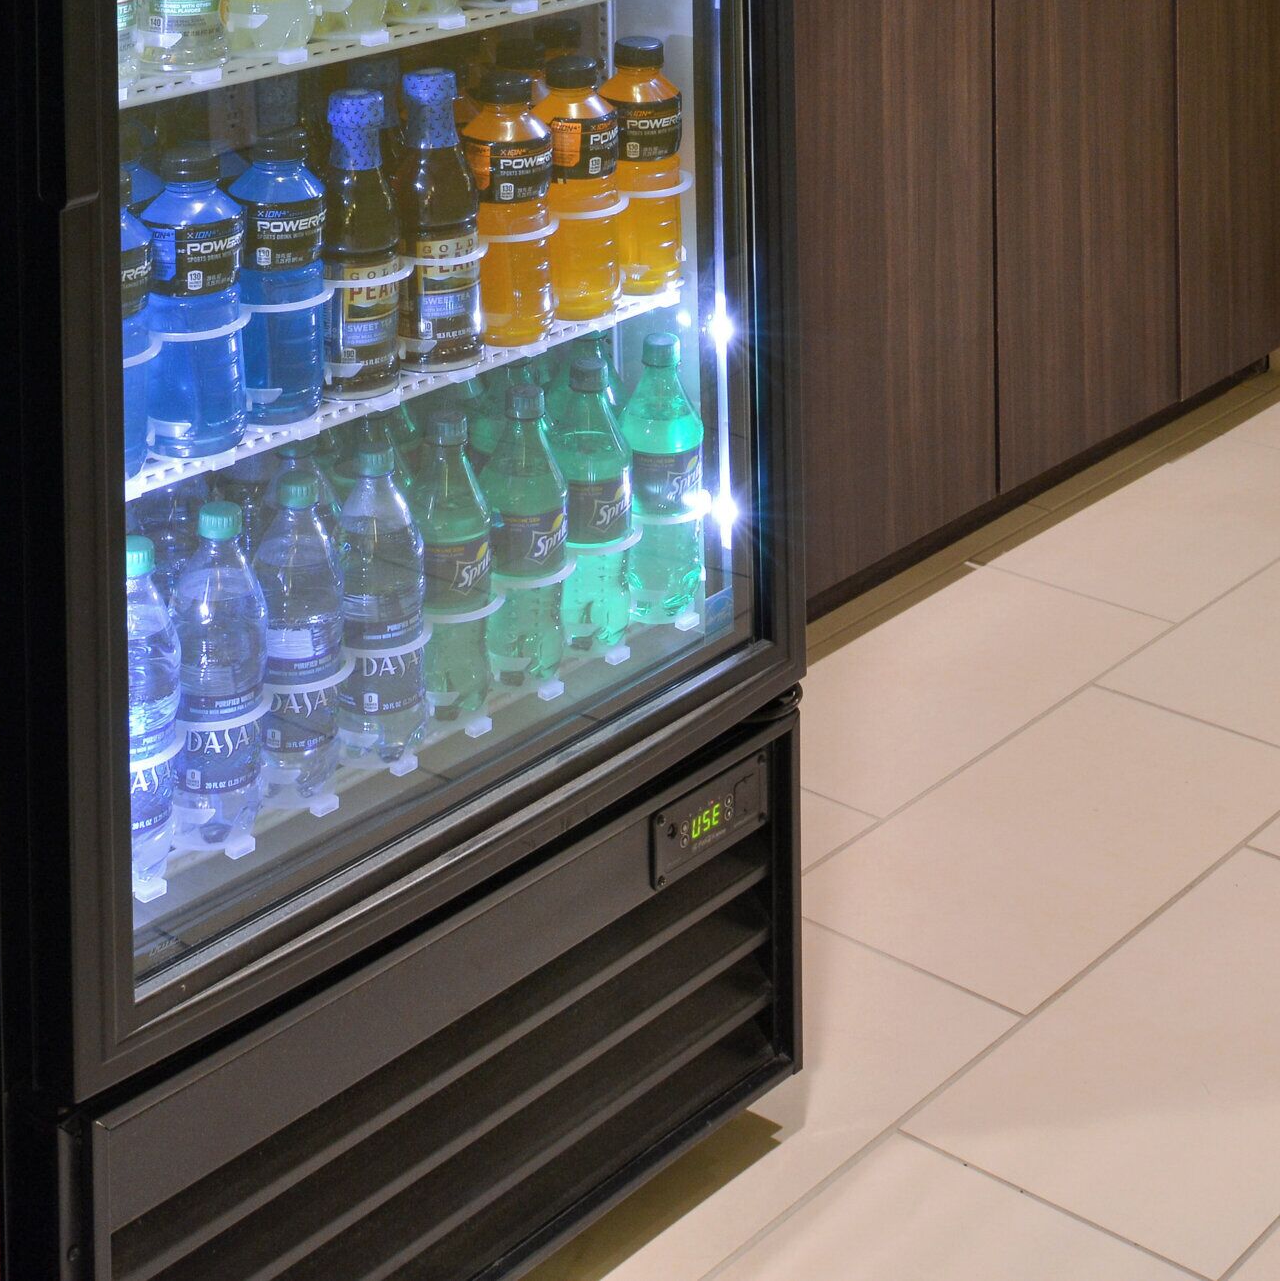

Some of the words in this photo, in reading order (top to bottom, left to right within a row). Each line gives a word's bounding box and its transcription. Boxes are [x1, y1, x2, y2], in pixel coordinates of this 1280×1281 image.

[501, 184, 513, 193] 130
[422, 237, 474, 255] GOLD
[189, 272, 202, 281] 130
[423, 295, 455, 307] SWEET
[457, 292, 471, 304] TEA
[347, 322, 378, 333] SWEET
[691, 803, 720, 839] USE
